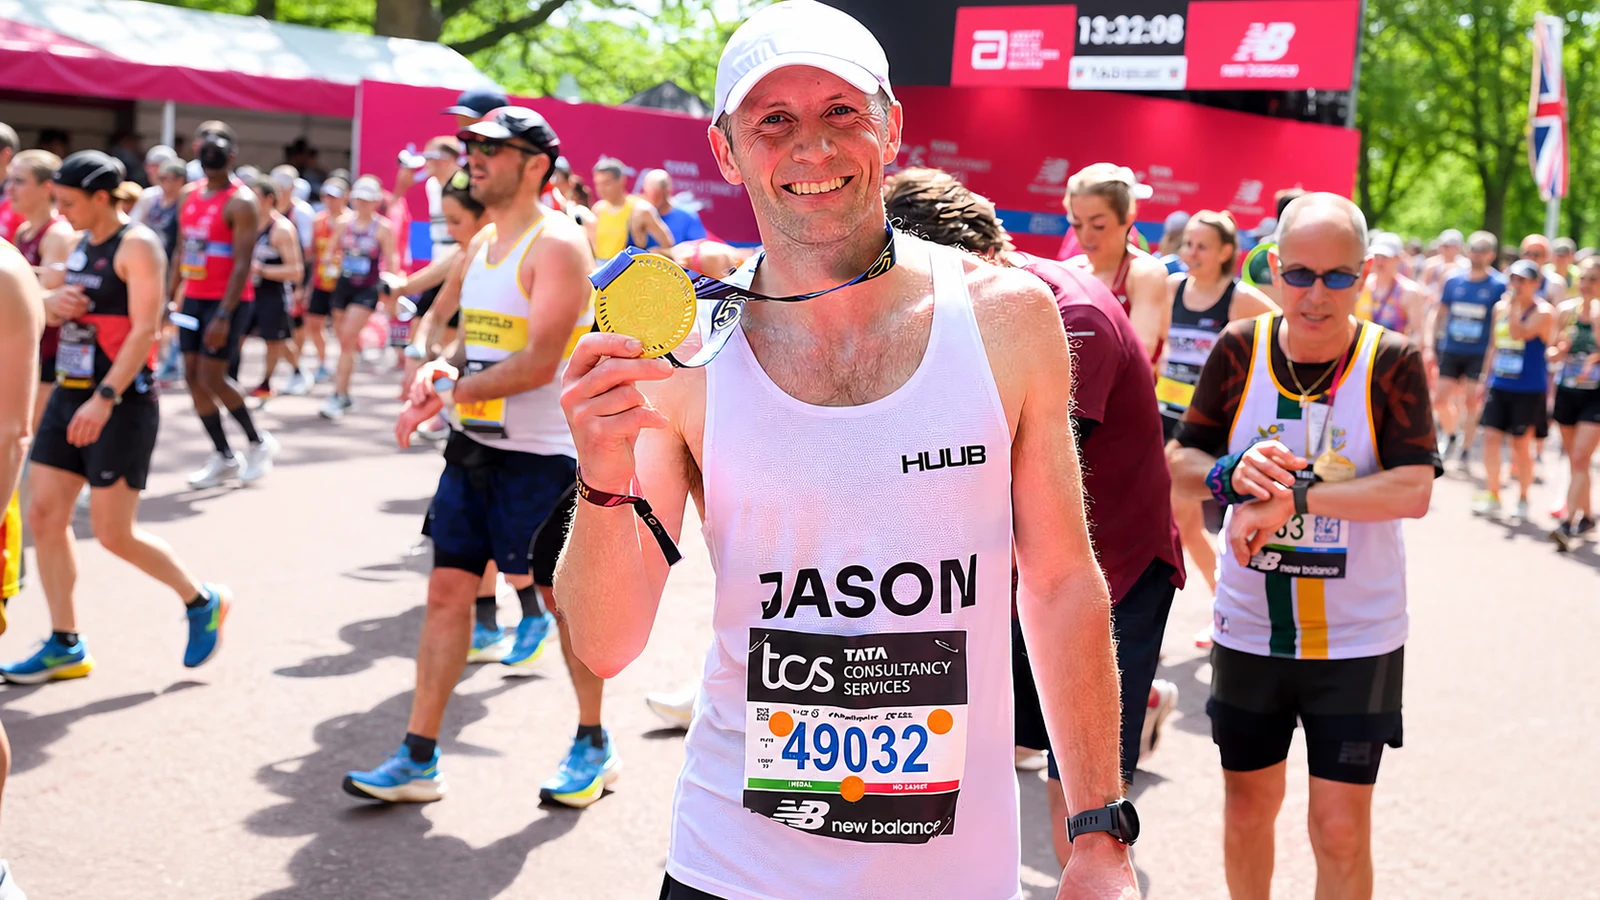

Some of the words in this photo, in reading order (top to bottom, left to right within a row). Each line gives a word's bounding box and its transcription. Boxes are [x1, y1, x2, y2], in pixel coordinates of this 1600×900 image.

[1078, 13, 1185, 45] 13:32:08
[901, 444, 987, 474] HUUB
[759, 553, 978, 620] JASON
[762, 642, 835, 693] tcs
[843, 646, 889, 663] TATA
[843, 661, 952, 679] CONSULTANCY
[843, 679, 911, 696] SERVICES
[781, 721, 929, 774] 49032
[831, 820, 868, 834] new
[871, 818, 942, 835] balance
